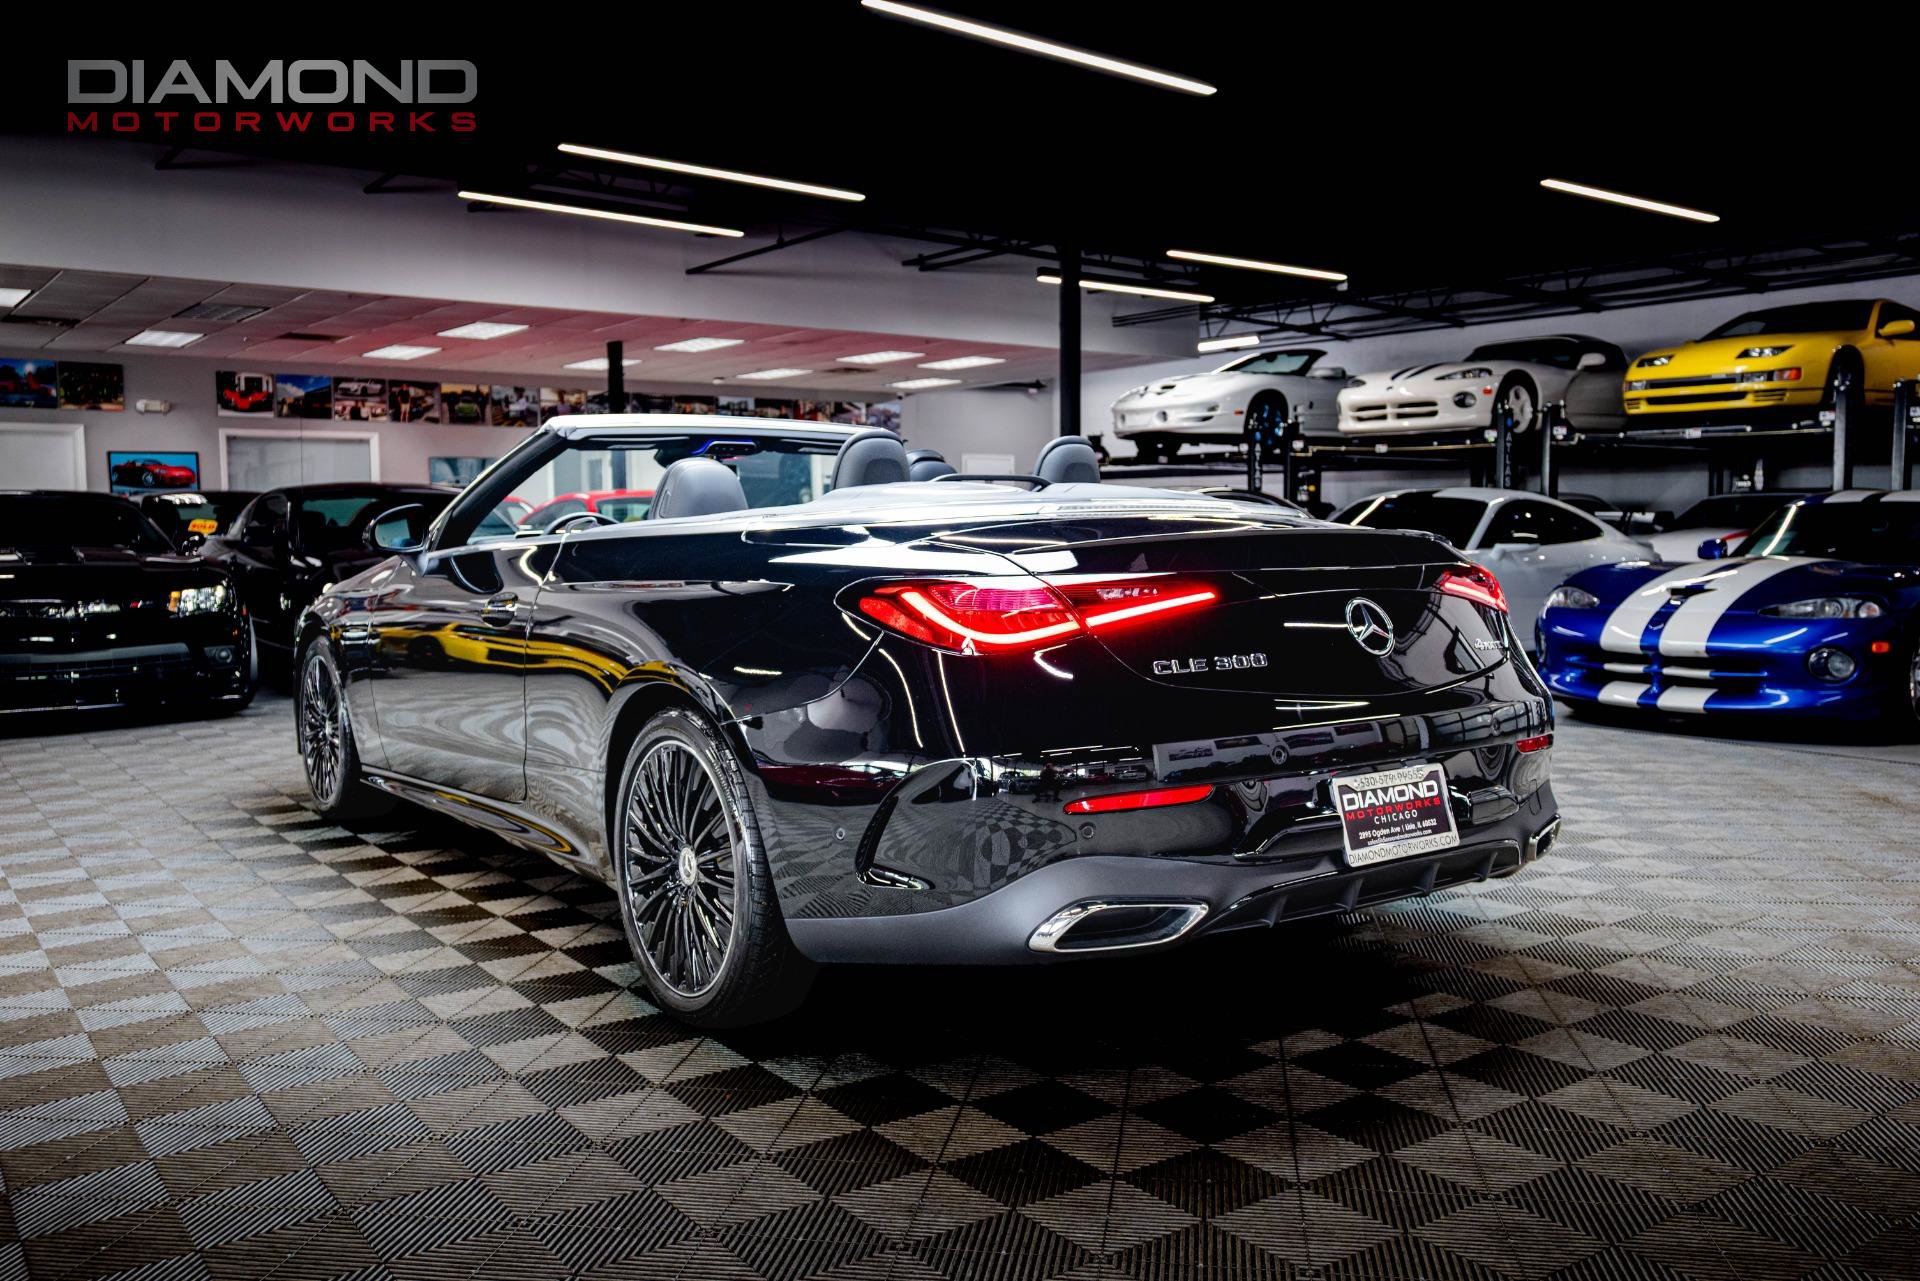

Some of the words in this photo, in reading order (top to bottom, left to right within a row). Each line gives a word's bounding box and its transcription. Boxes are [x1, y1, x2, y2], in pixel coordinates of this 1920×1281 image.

[1152, 658, 1209, 675] CLE
[1214, 653, 1268, 671] 300
[1342, 780, 1438, 811] DIAMOND
[1346, 797, 1440, 821] MOTORWORKS
[1374, 810, 1417, 824] CHICAGO
[1372, 828, 1390, 837] Ogden
[1390, 825, 1400, 833] Ave
